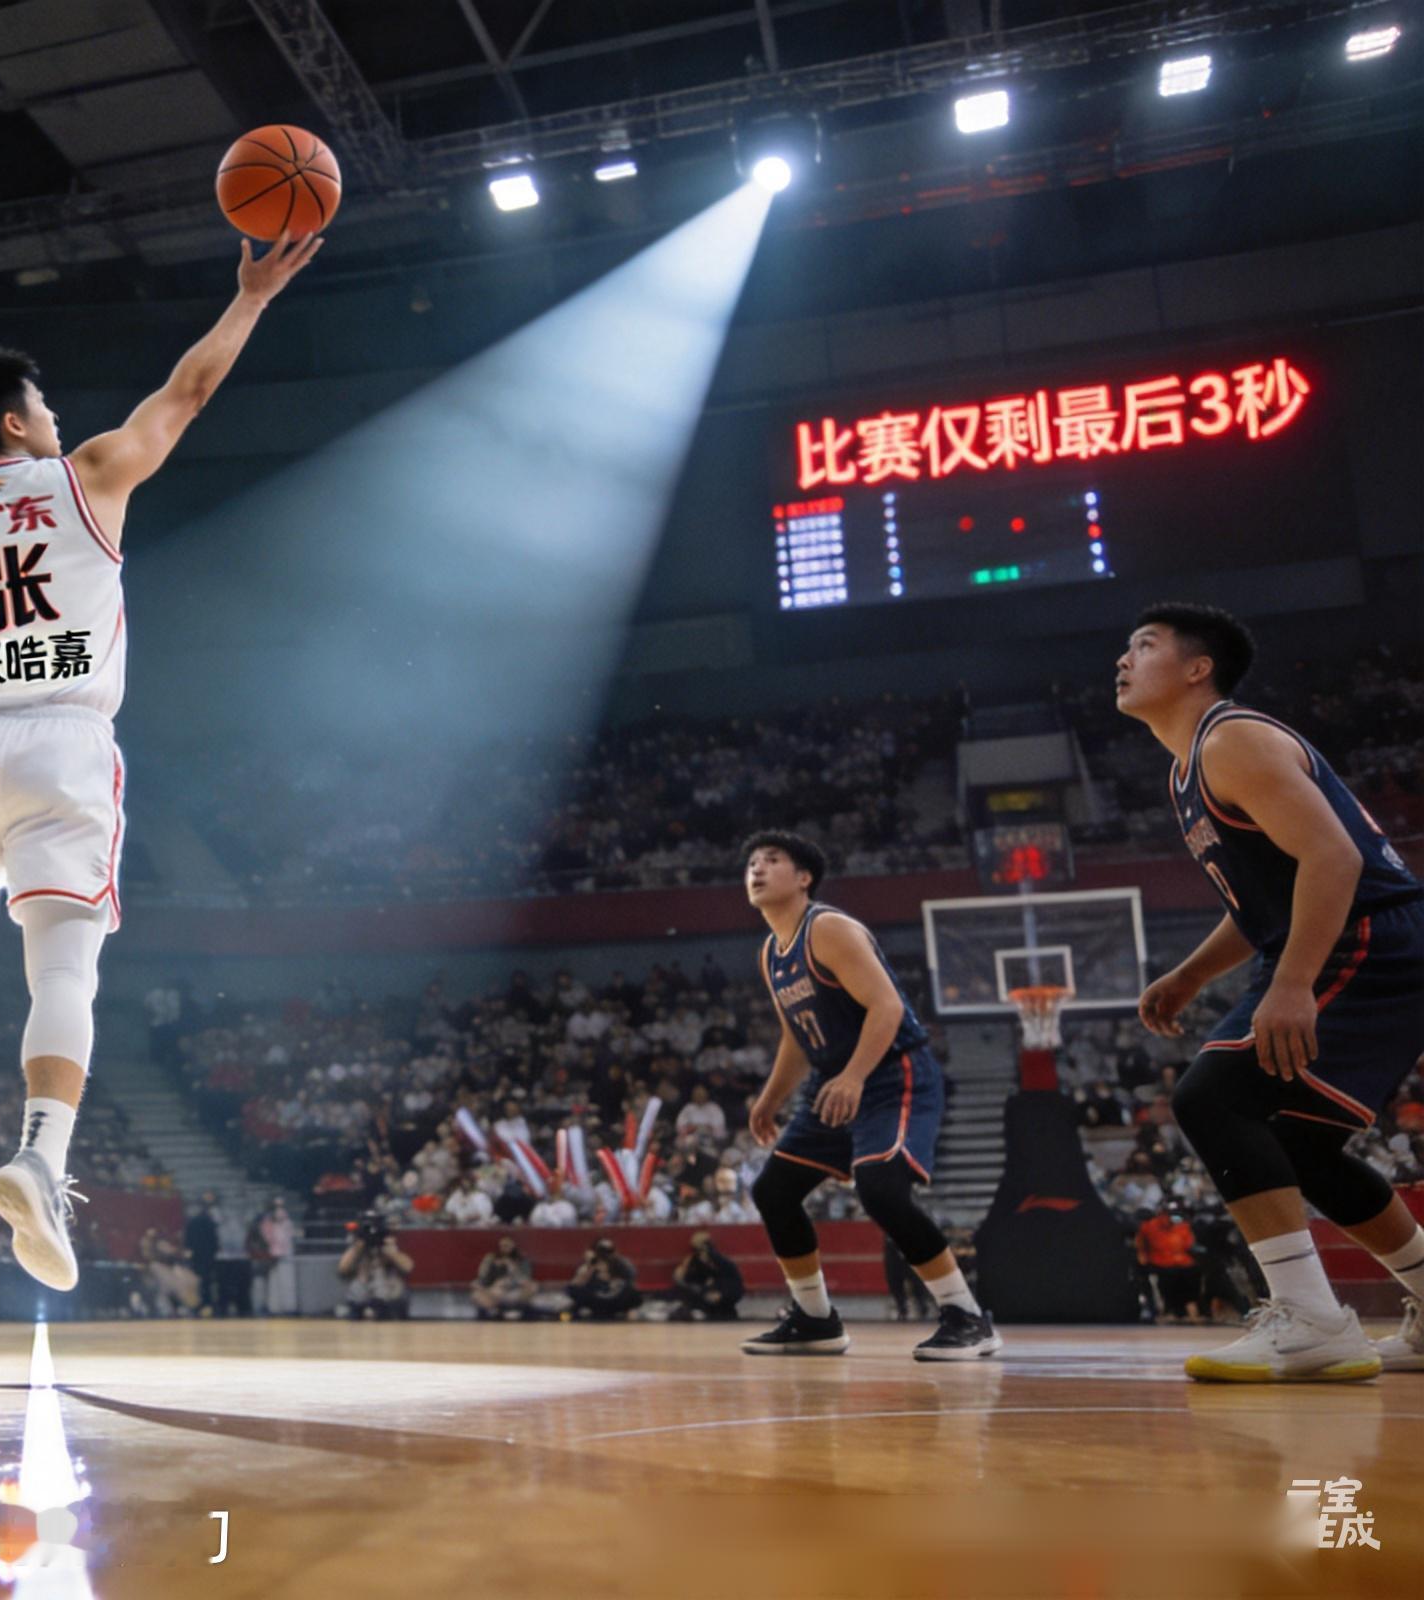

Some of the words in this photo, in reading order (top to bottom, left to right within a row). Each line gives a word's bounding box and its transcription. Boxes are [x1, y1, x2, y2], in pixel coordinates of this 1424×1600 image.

[795, 358, 1311, 491] 比赛仅剩最后3秒
